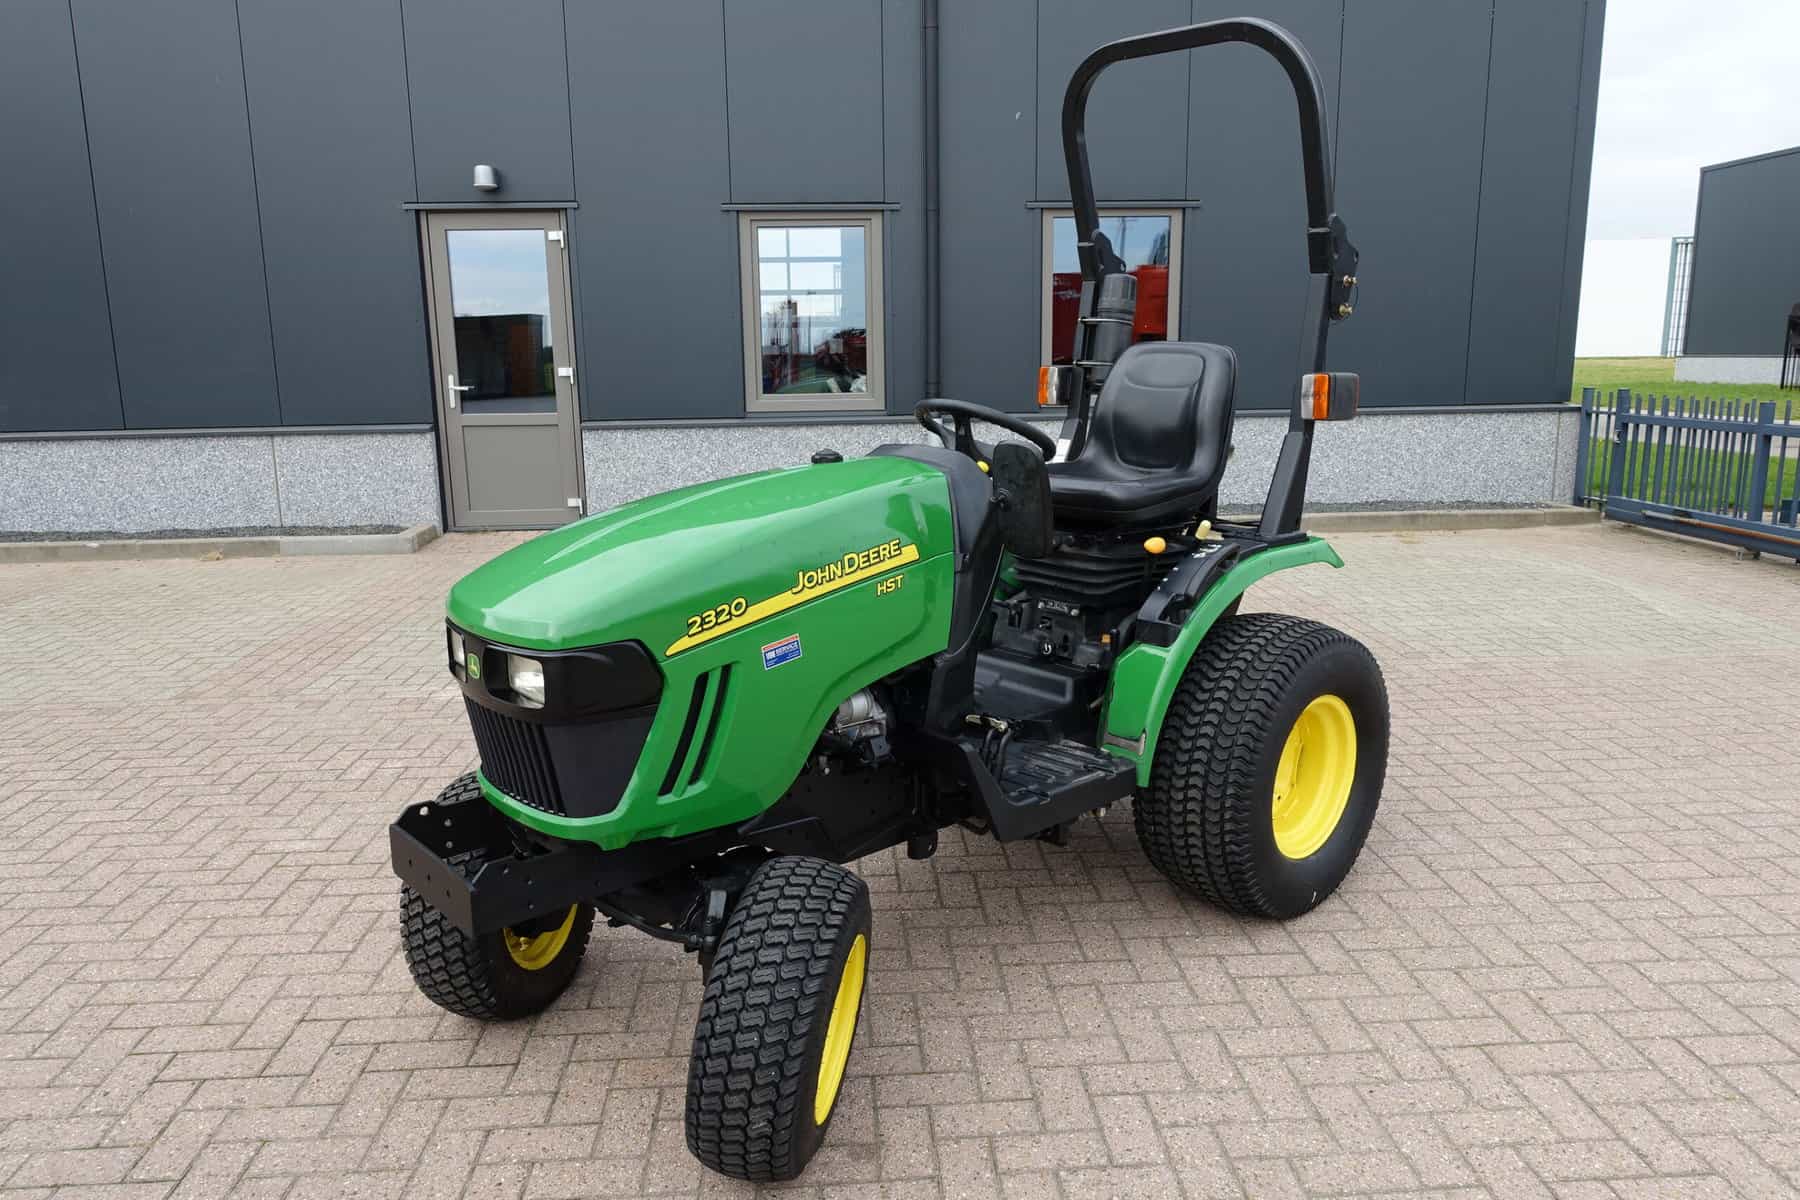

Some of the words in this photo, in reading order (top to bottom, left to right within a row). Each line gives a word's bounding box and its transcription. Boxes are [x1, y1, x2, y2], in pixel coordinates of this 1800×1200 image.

[792, 560, 843, 594] JOHN
[844, 539, 902, 574] DEERE
[876, 574, 904, 596] HST
[687, 597, 748, 637] 2320
